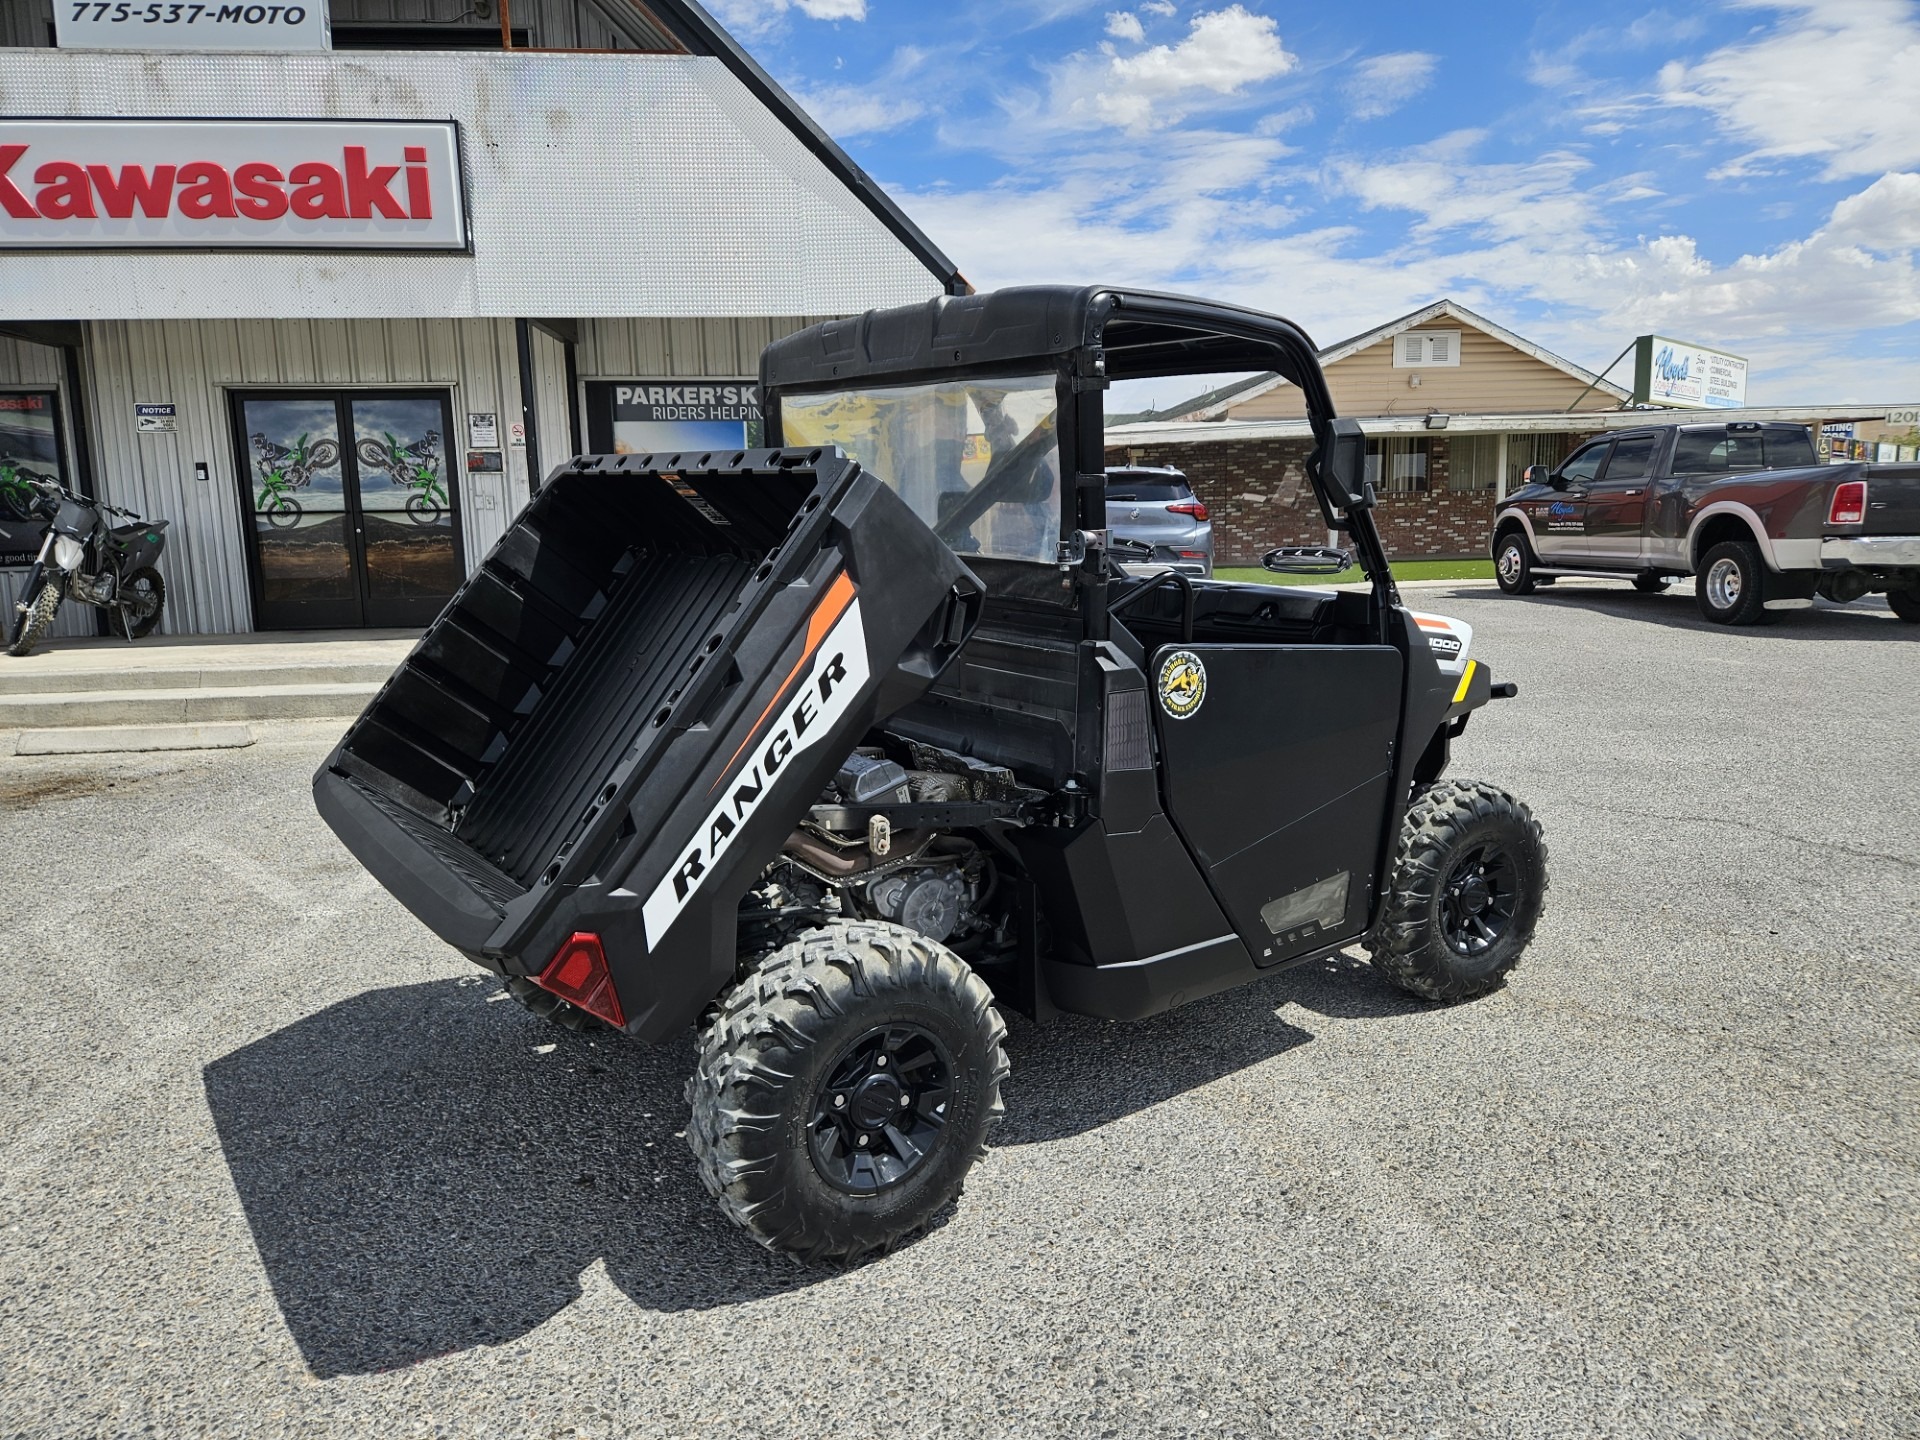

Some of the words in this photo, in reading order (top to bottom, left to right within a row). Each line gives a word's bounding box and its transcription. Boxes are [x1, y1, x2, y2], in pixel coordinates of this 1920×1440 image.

[71, 2, 306, 25] 775-537-MOTO
[0, 144, 432, 220] Kawasaki
[616, 387, 738, 405] PARKER'S
[652, 406, 706, 420] RIDERS
[1821, 422, 1853, 432] RTING
[4, 553, 26, 564] good
[1428, 637, 1461, 650] 1000
[672, 652, 847, 904] RANGER
